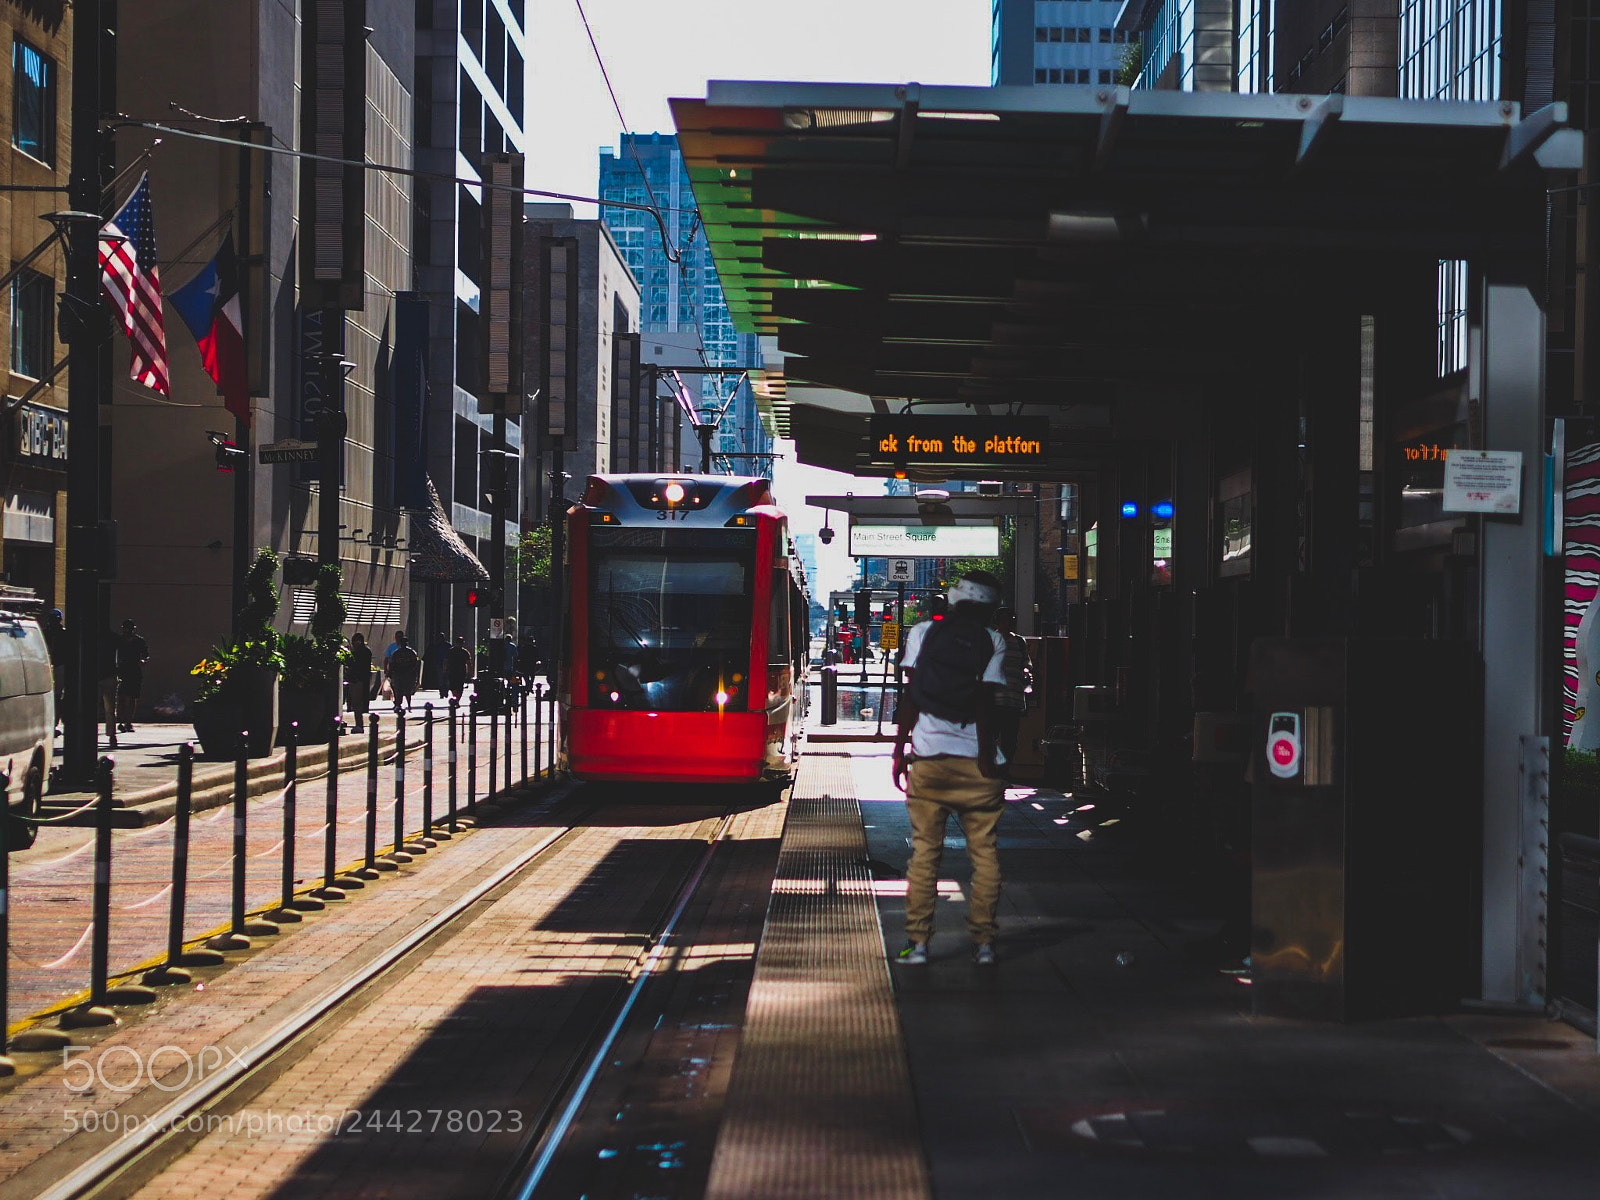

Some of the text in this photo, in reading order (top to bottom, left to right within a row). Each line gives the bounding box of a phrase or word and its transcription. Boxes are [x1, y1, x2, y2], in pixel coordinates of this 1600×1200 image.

[303, 310, 323, 354] MA
[30, 411, 68, 460] IBC BA
[906, 434, 943, 454] from
[952, 435, 976, 454] the
[656, 510, 689, 521] 317
[853, 532, 936, 542] Main Street Square
